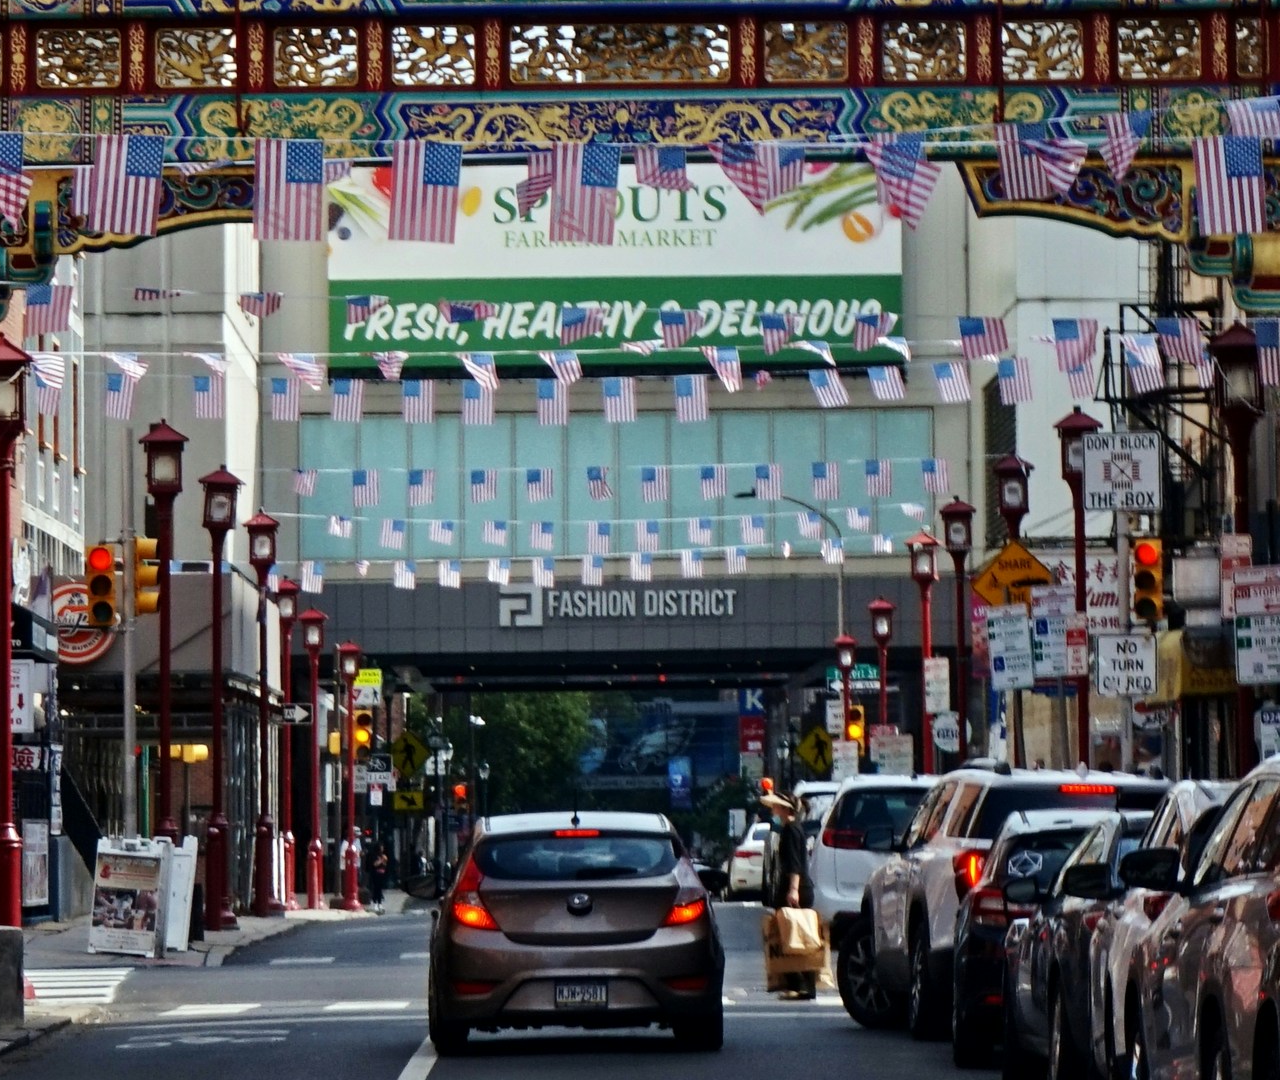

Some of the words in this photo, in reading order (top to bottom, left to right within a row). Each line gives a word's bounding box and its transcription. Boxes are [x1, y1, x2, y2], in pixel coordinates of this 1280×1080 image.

[617, 228, 718, 248] MARKET
[1120, 435, 1156, 451] BLOCK
[1089, 491, 1118, 507] THE
[1124, 491, 1156, 507] BOX
[547, 589, 637, 618] FASHION
[644, 588, 738, 618] DISTRICT
[1116, 641, 1138, 655] NO
[1110, 658, 1144, 671] TURN
